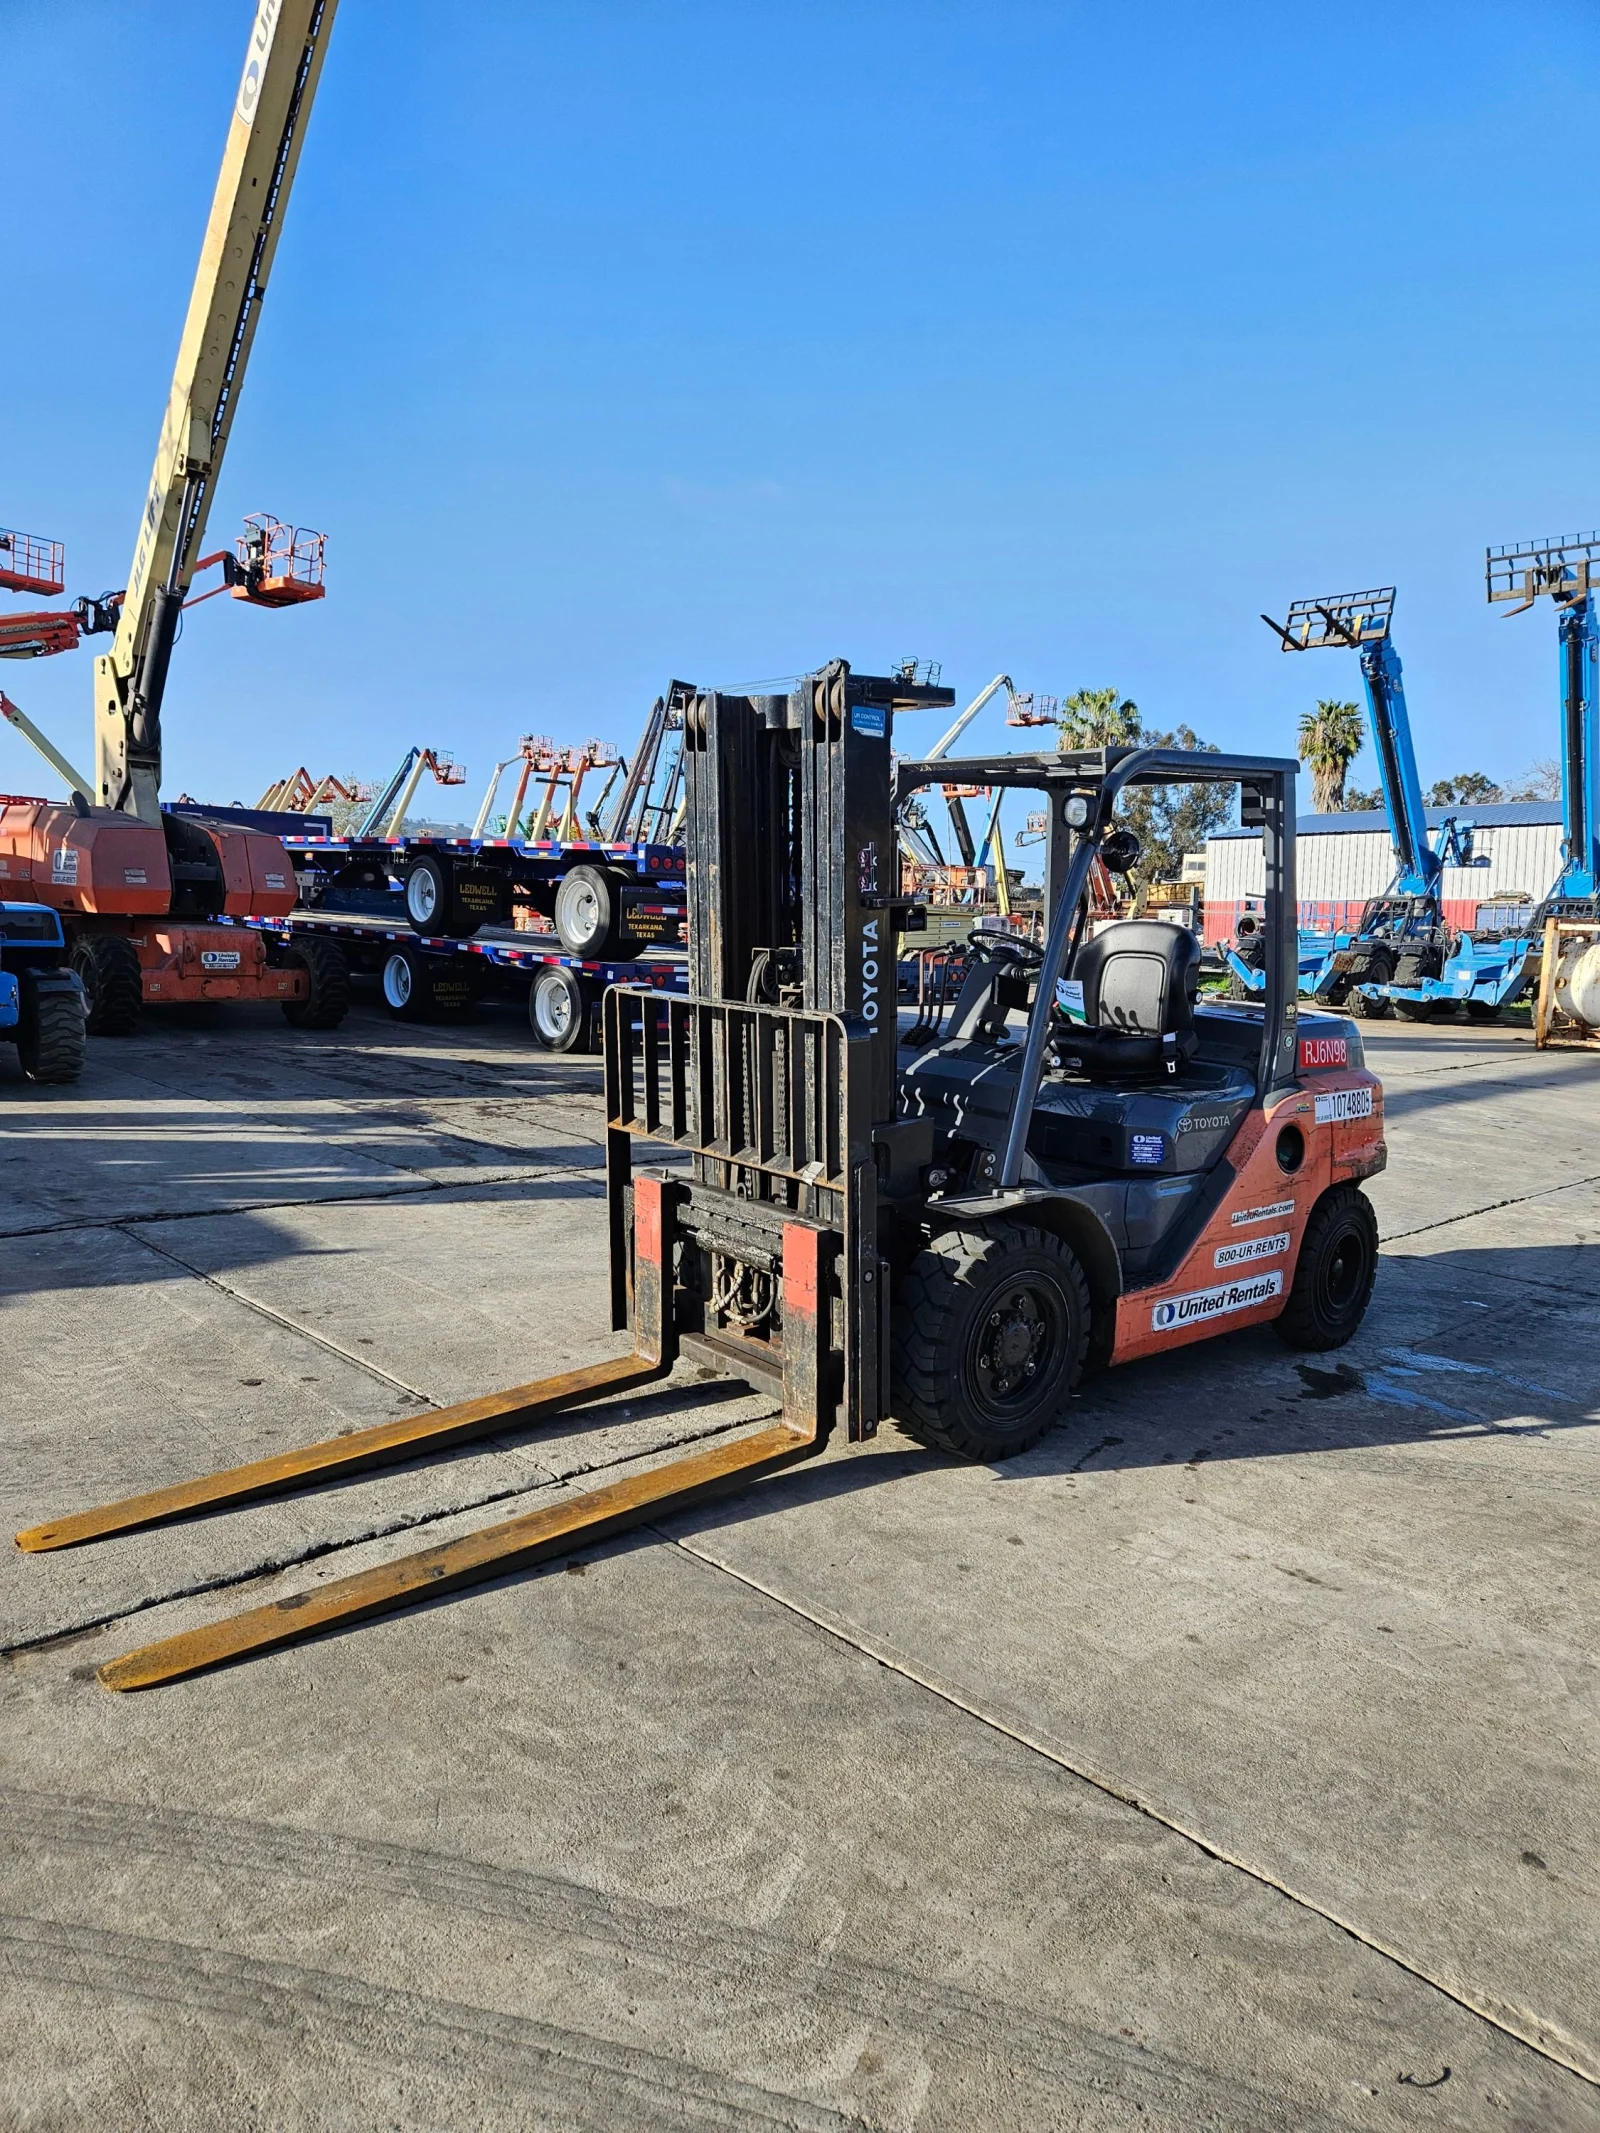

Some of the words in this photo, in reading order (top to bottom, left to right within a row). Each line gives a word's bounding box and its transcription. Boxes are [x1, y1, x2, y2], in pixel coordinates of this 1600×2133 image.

[133, 544, 146, 598] JLG
[144, 481, 160, 547] LIFT
[460, 884, 497, 895] LEDWELL
[628, 923, 664, 931] TEXARKANA,
[433, 982, 470, 992] LEDWELL
[1305, 1040, 1347, 1064] RJ6N98
[1332, 1091, 1370, 1118] 10748805
[1193, 1116, 1230, 1130] TOYOTA
[1218, 1237, 1287, 1263] 800-UR-RENTS
[1178, 1290, 1226, 1319] United
[1227, 1278, 1276, 1306] Rentals
